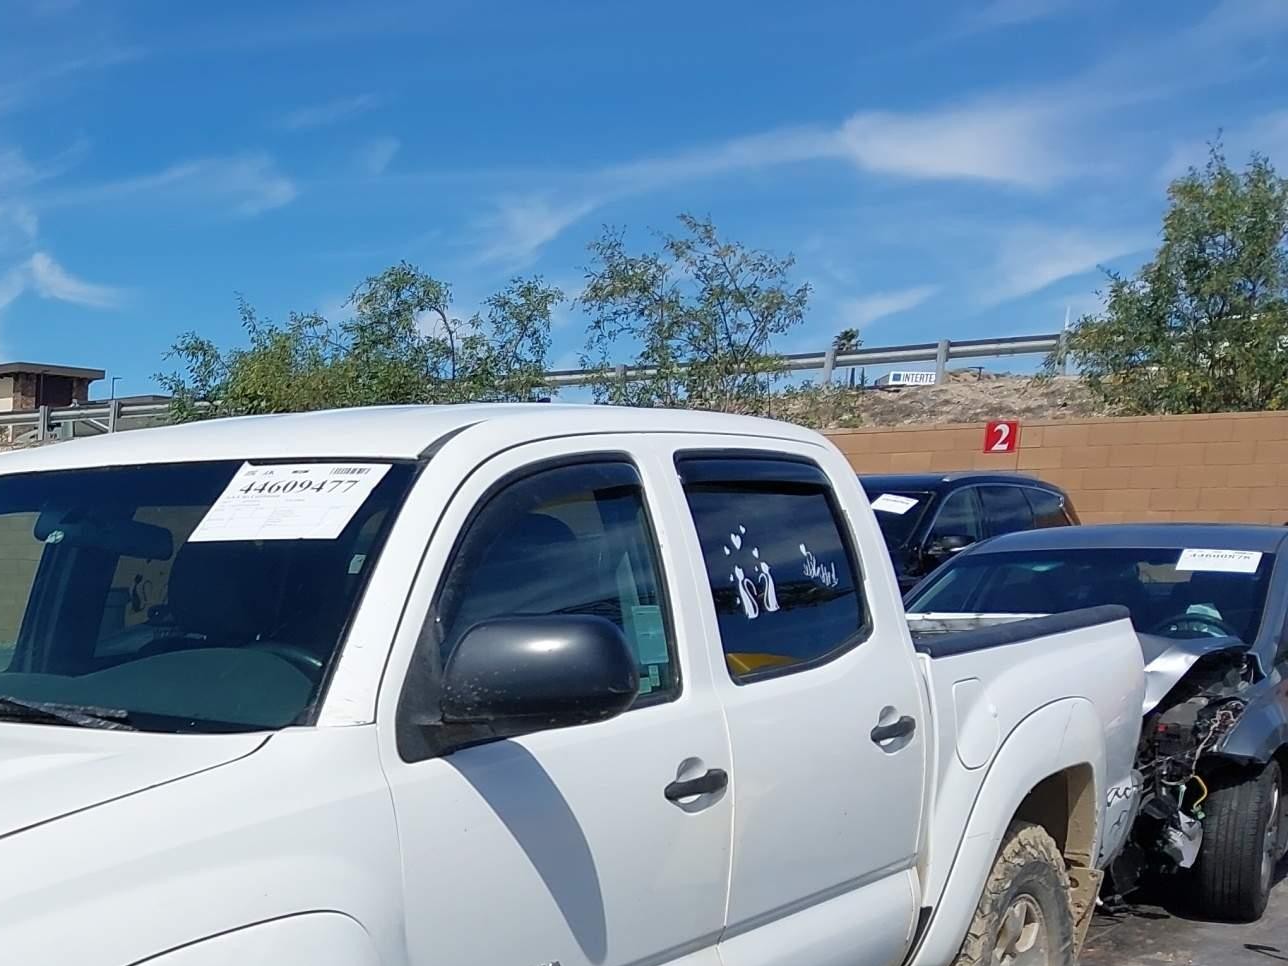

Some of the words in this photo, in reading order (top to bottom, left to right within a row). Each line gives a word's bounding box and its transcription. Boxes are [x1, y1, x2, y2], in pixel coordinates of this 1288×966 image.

[903, 372, 936, 385] INTERTE
[991, 423, 1010, 451] 2
[239, 479, 360, 495] 44609477
